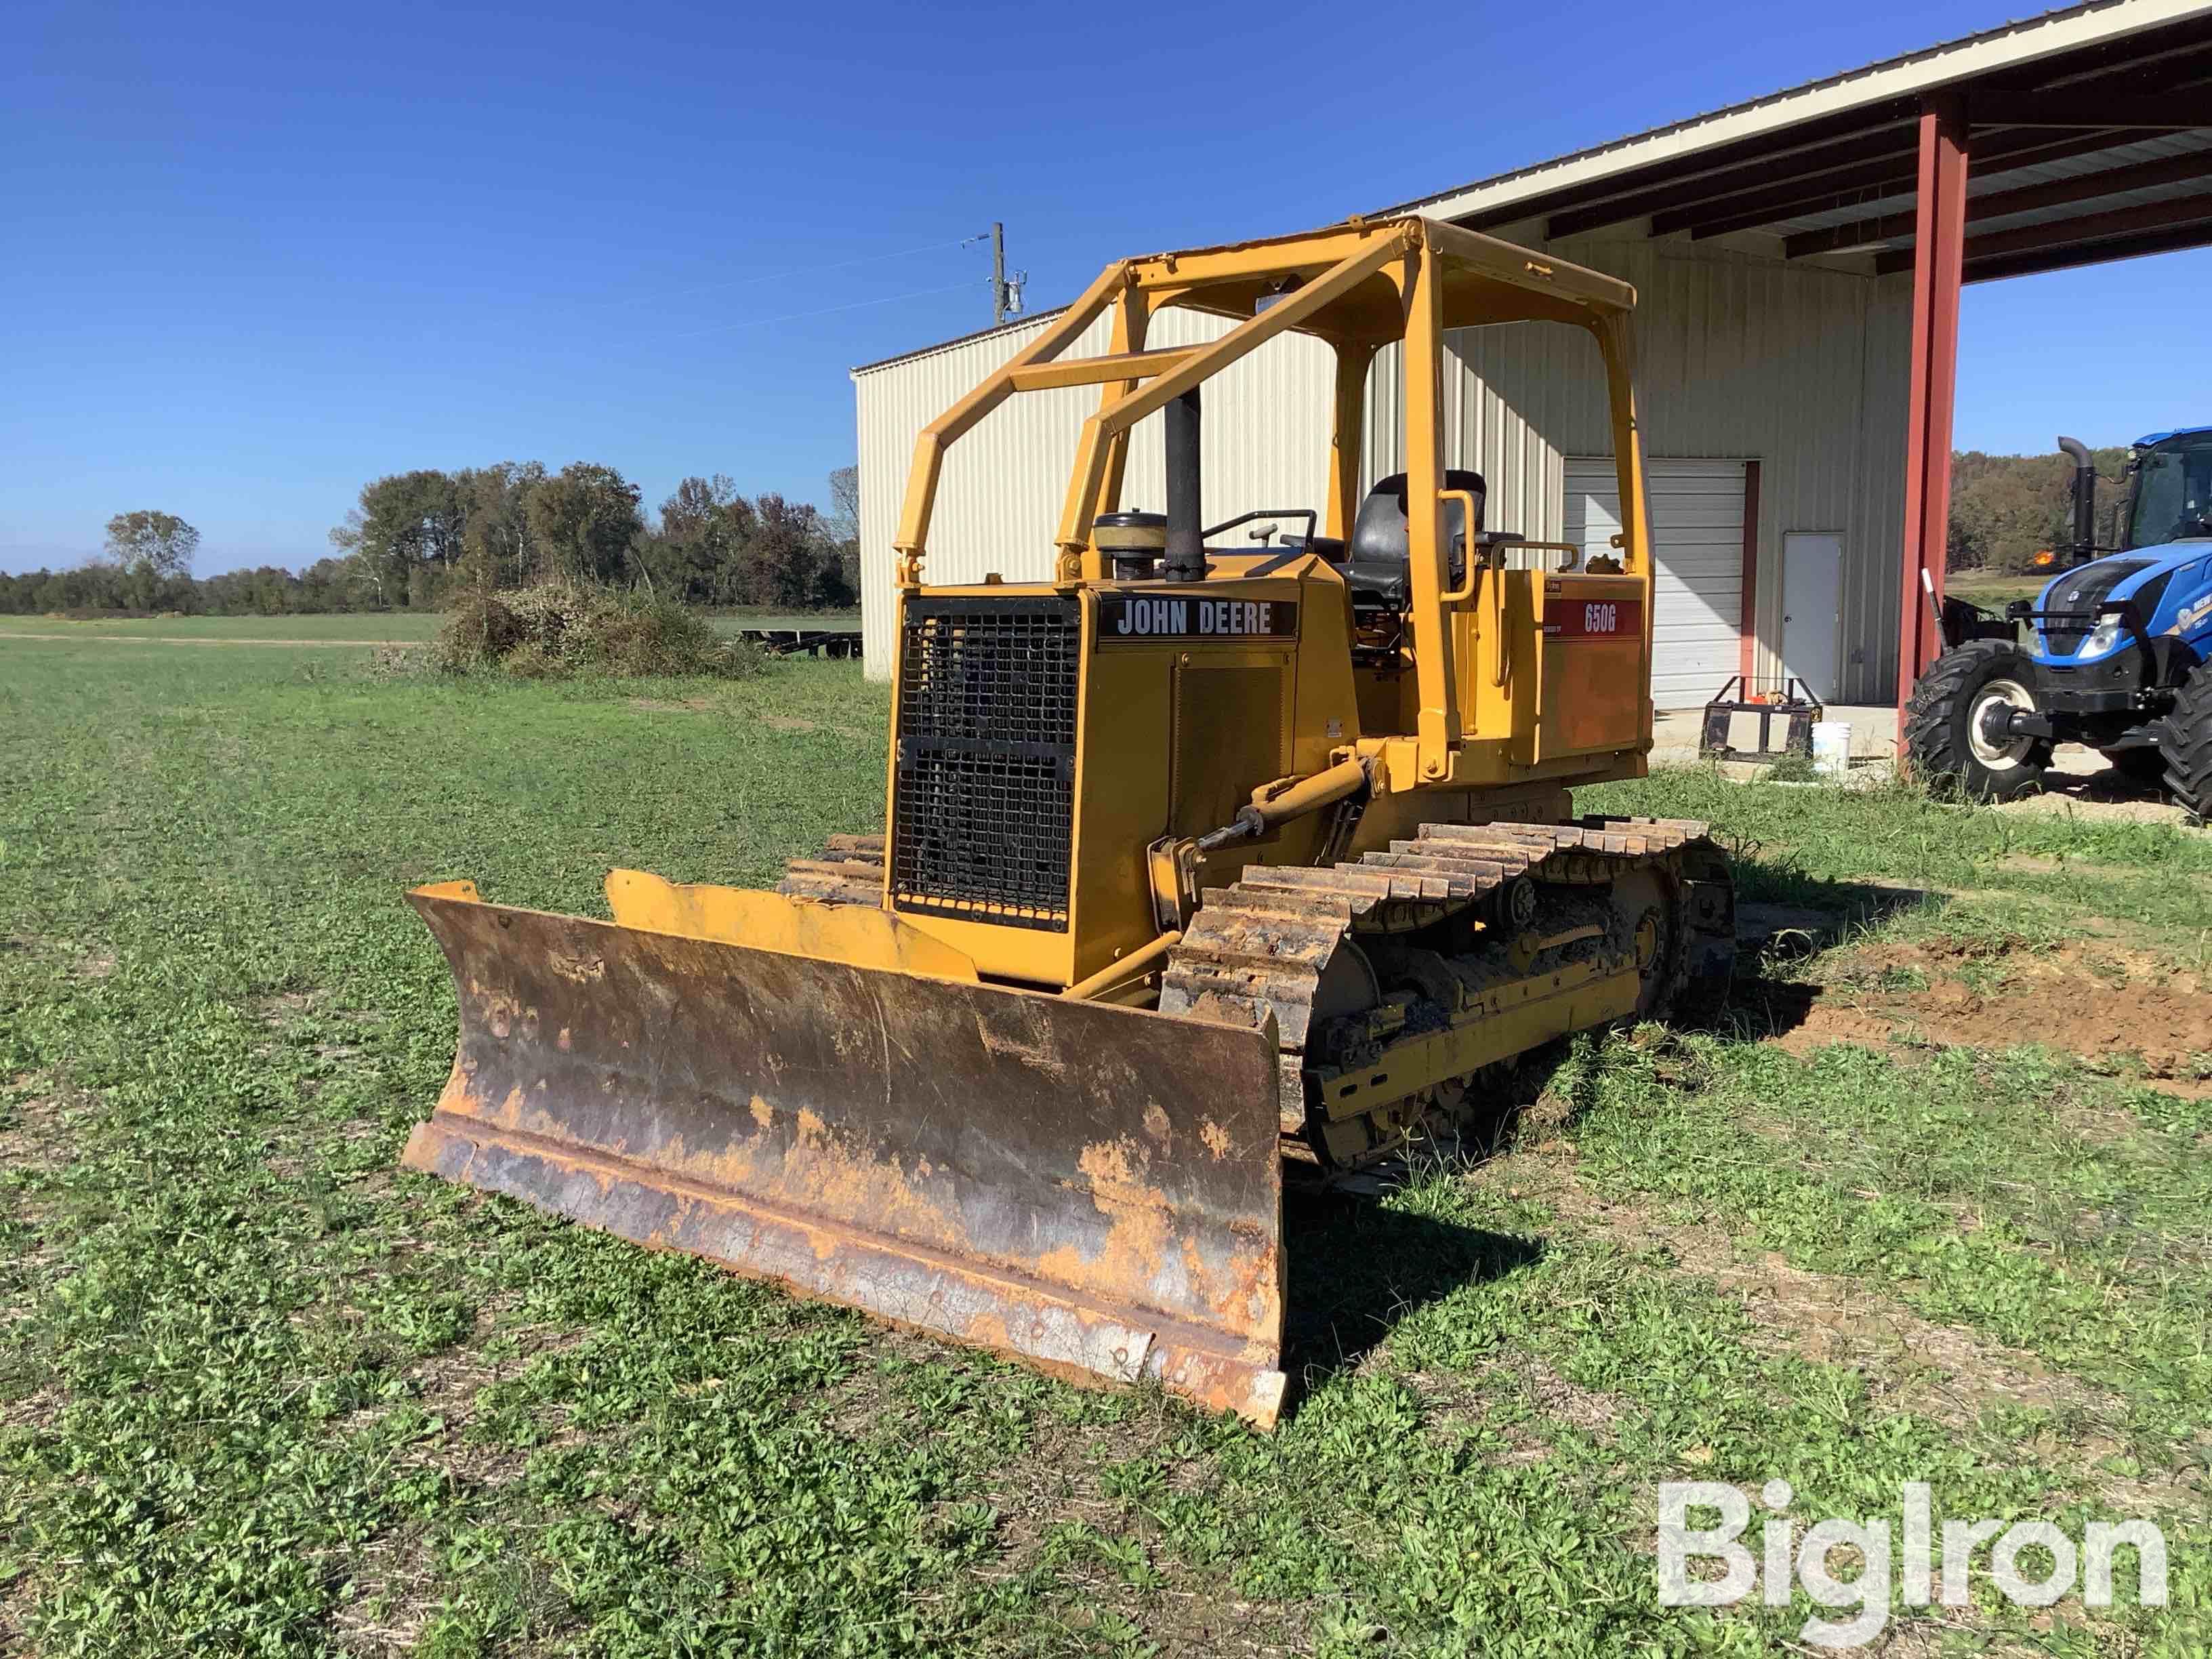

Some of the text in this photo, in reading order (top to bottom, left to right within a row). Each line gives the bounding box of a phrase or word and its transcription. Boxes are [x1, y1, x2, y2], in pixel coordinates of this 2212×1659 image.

[1118, 599, 1271, 634] JOHN DEERE
[1584, 603, 1616, 632] 650G
